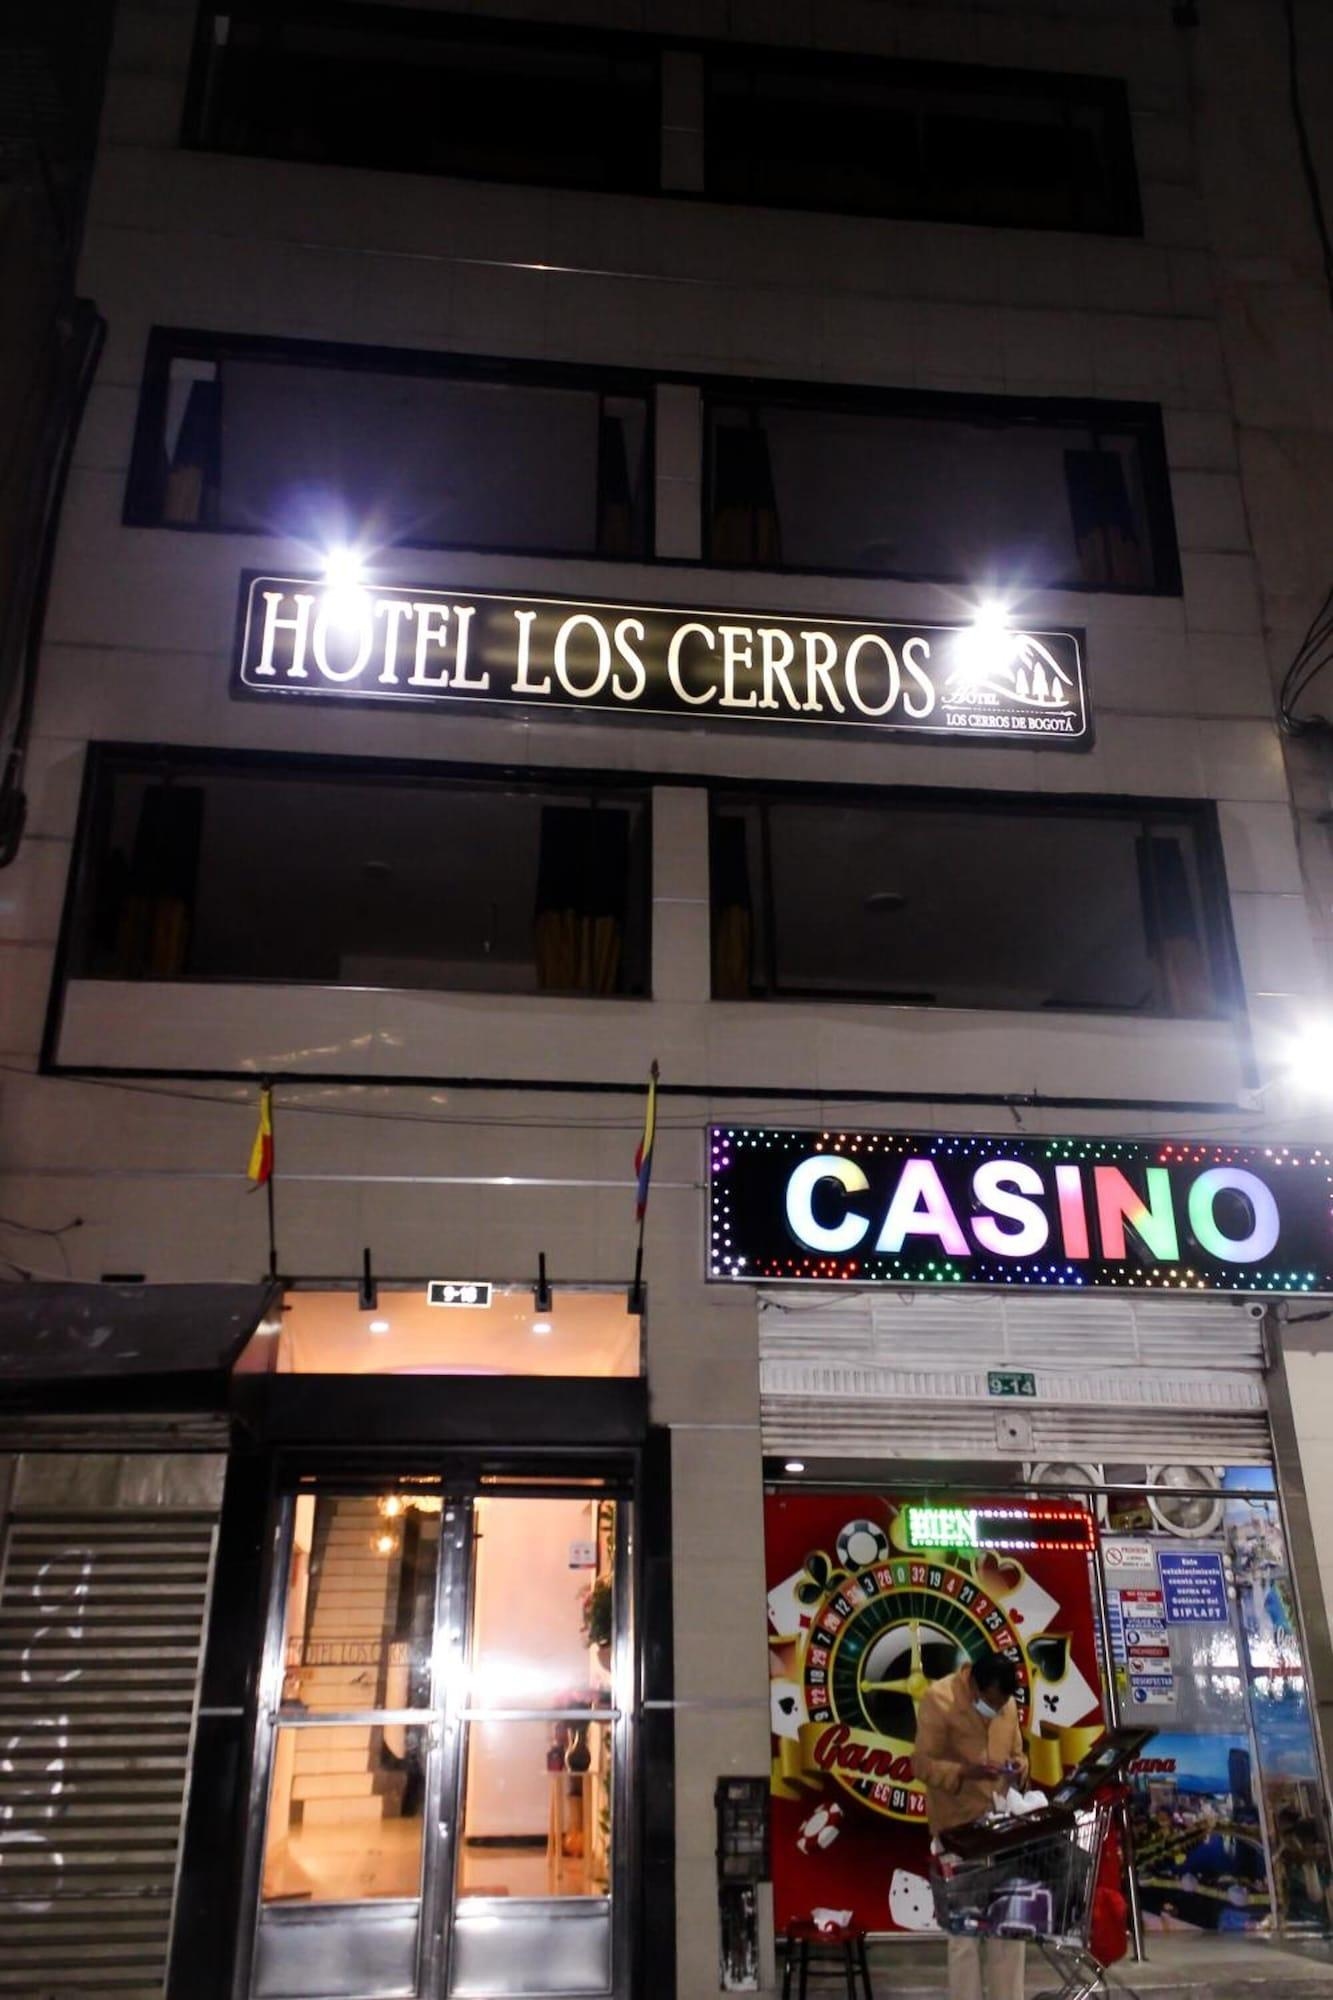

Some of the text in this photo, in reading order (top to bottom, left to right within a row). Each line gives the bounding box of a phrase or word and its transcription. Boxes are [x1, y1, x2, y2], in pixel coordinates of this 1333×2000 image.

[255, 589, 935, 719] HOTEL LOS CERROS
[946, 714, 1074, 732] LOS CERROS DE BOGOTÁ
[784, 1155, 1281, 1264] CASINO
[991, 1378, 1033, 1395] 9-14
[878, 1569, 893, 1587] 26
[897, 1568, 905, 1583] 0
[912, 1567, 925, 1583] 32
[930, 1571, 941, 1587] 19
[864, 1578, 874, 1593] 3
[947, 1578, 955, 1593] 4
[960, 1586, 974, 1603] 21
[835, 1598, 851, 1615] 12
[976, 1600, 988, 1614] 2
[1172, 1608, 1221, 1617] SIPLAFT
[985, 1612, 1003, 1630] 25
[817, 1632, 832, 1644] 7
[996, 1630, 1012, 1648] 17
[810, 1670, 825, 1683] 18
[811, 1688, 827, 1705] 22
[814, 1723, 916, 1783] Gana
[874, 1783, 890, 1802] 33
[893, 1790, 904, 1808] 16
